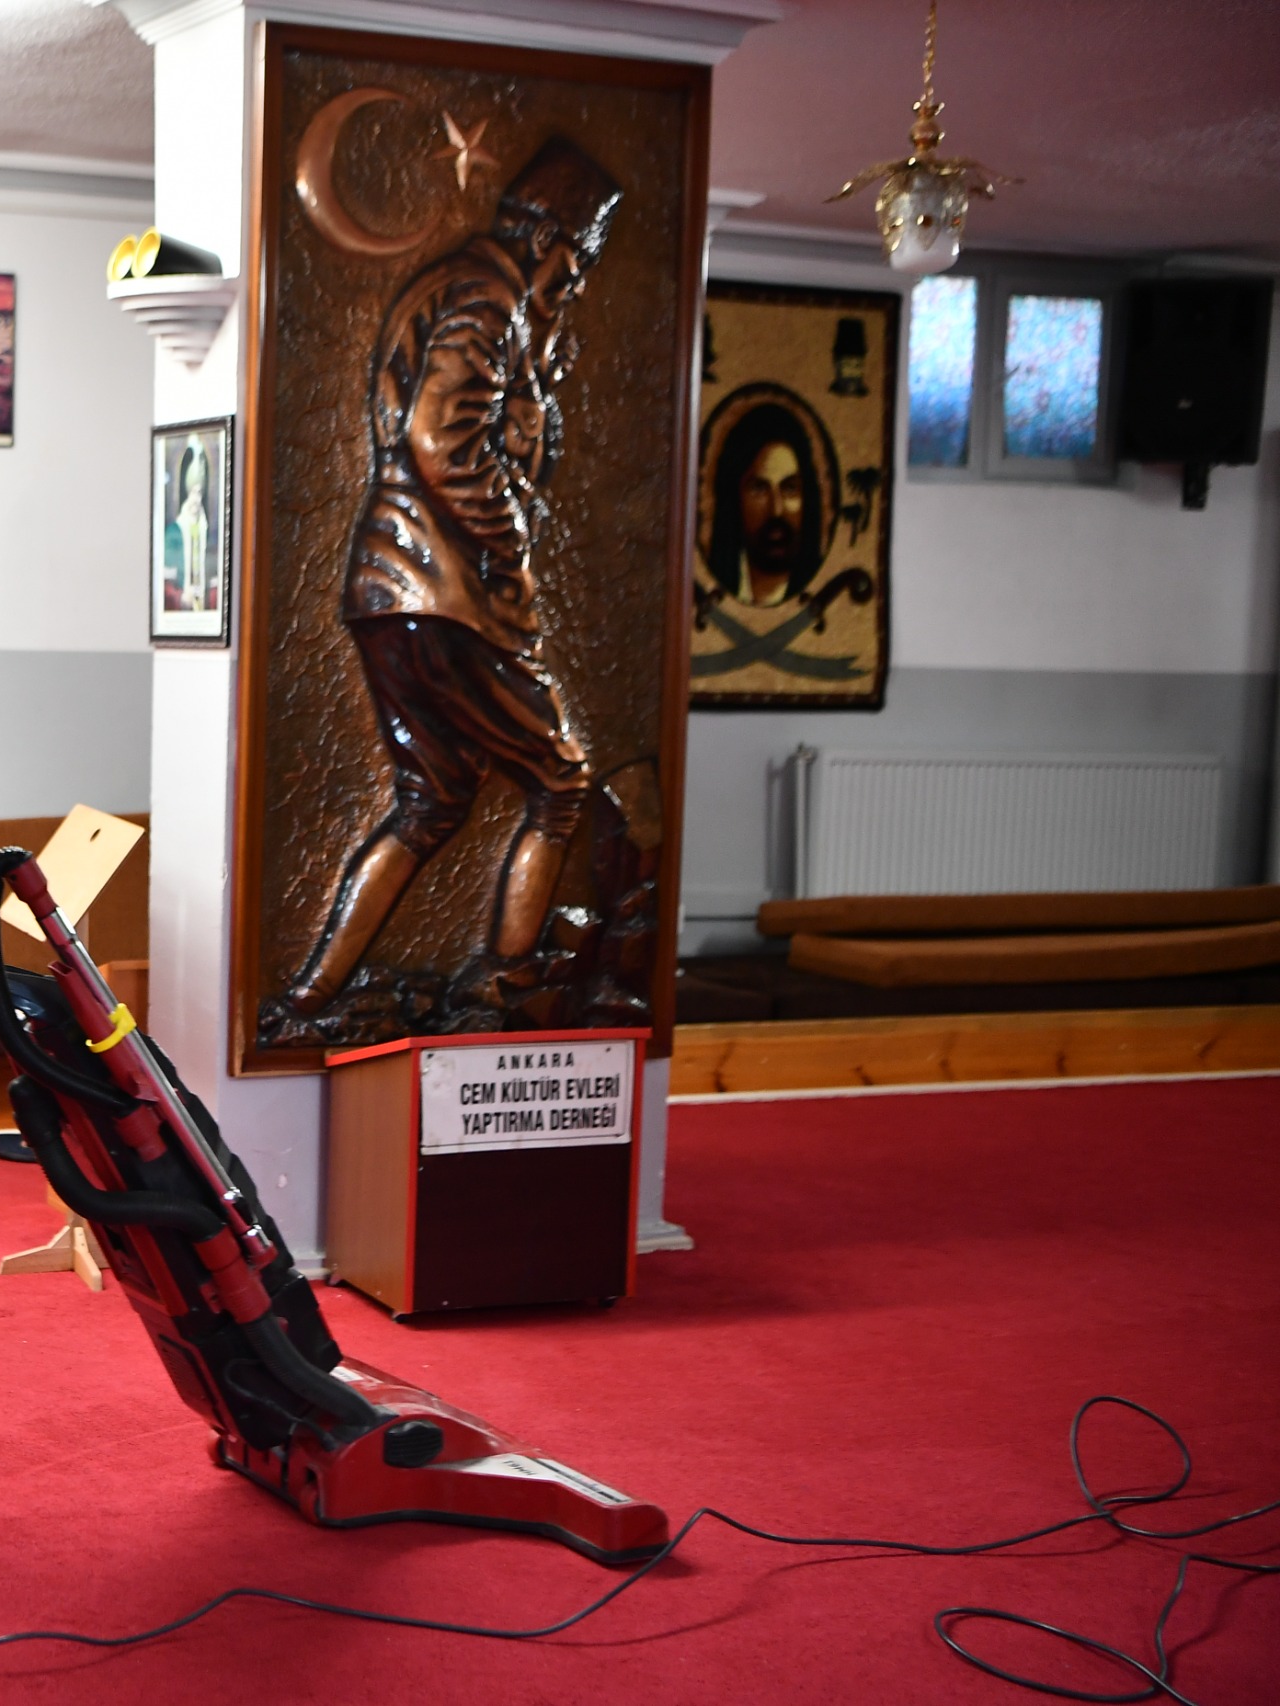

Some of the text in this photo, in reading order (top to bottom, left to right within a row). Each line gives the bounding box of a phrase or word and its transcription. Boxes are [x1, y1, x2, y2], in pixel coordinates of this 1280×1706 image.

[496, 1052, 575, 1070] ANKARA
[460, 1073, 620, 1105] CEM KÜLTÜR EVLERİ
[462, 1103, 616, 1135] YAPTIRMA DERNEĞİ
